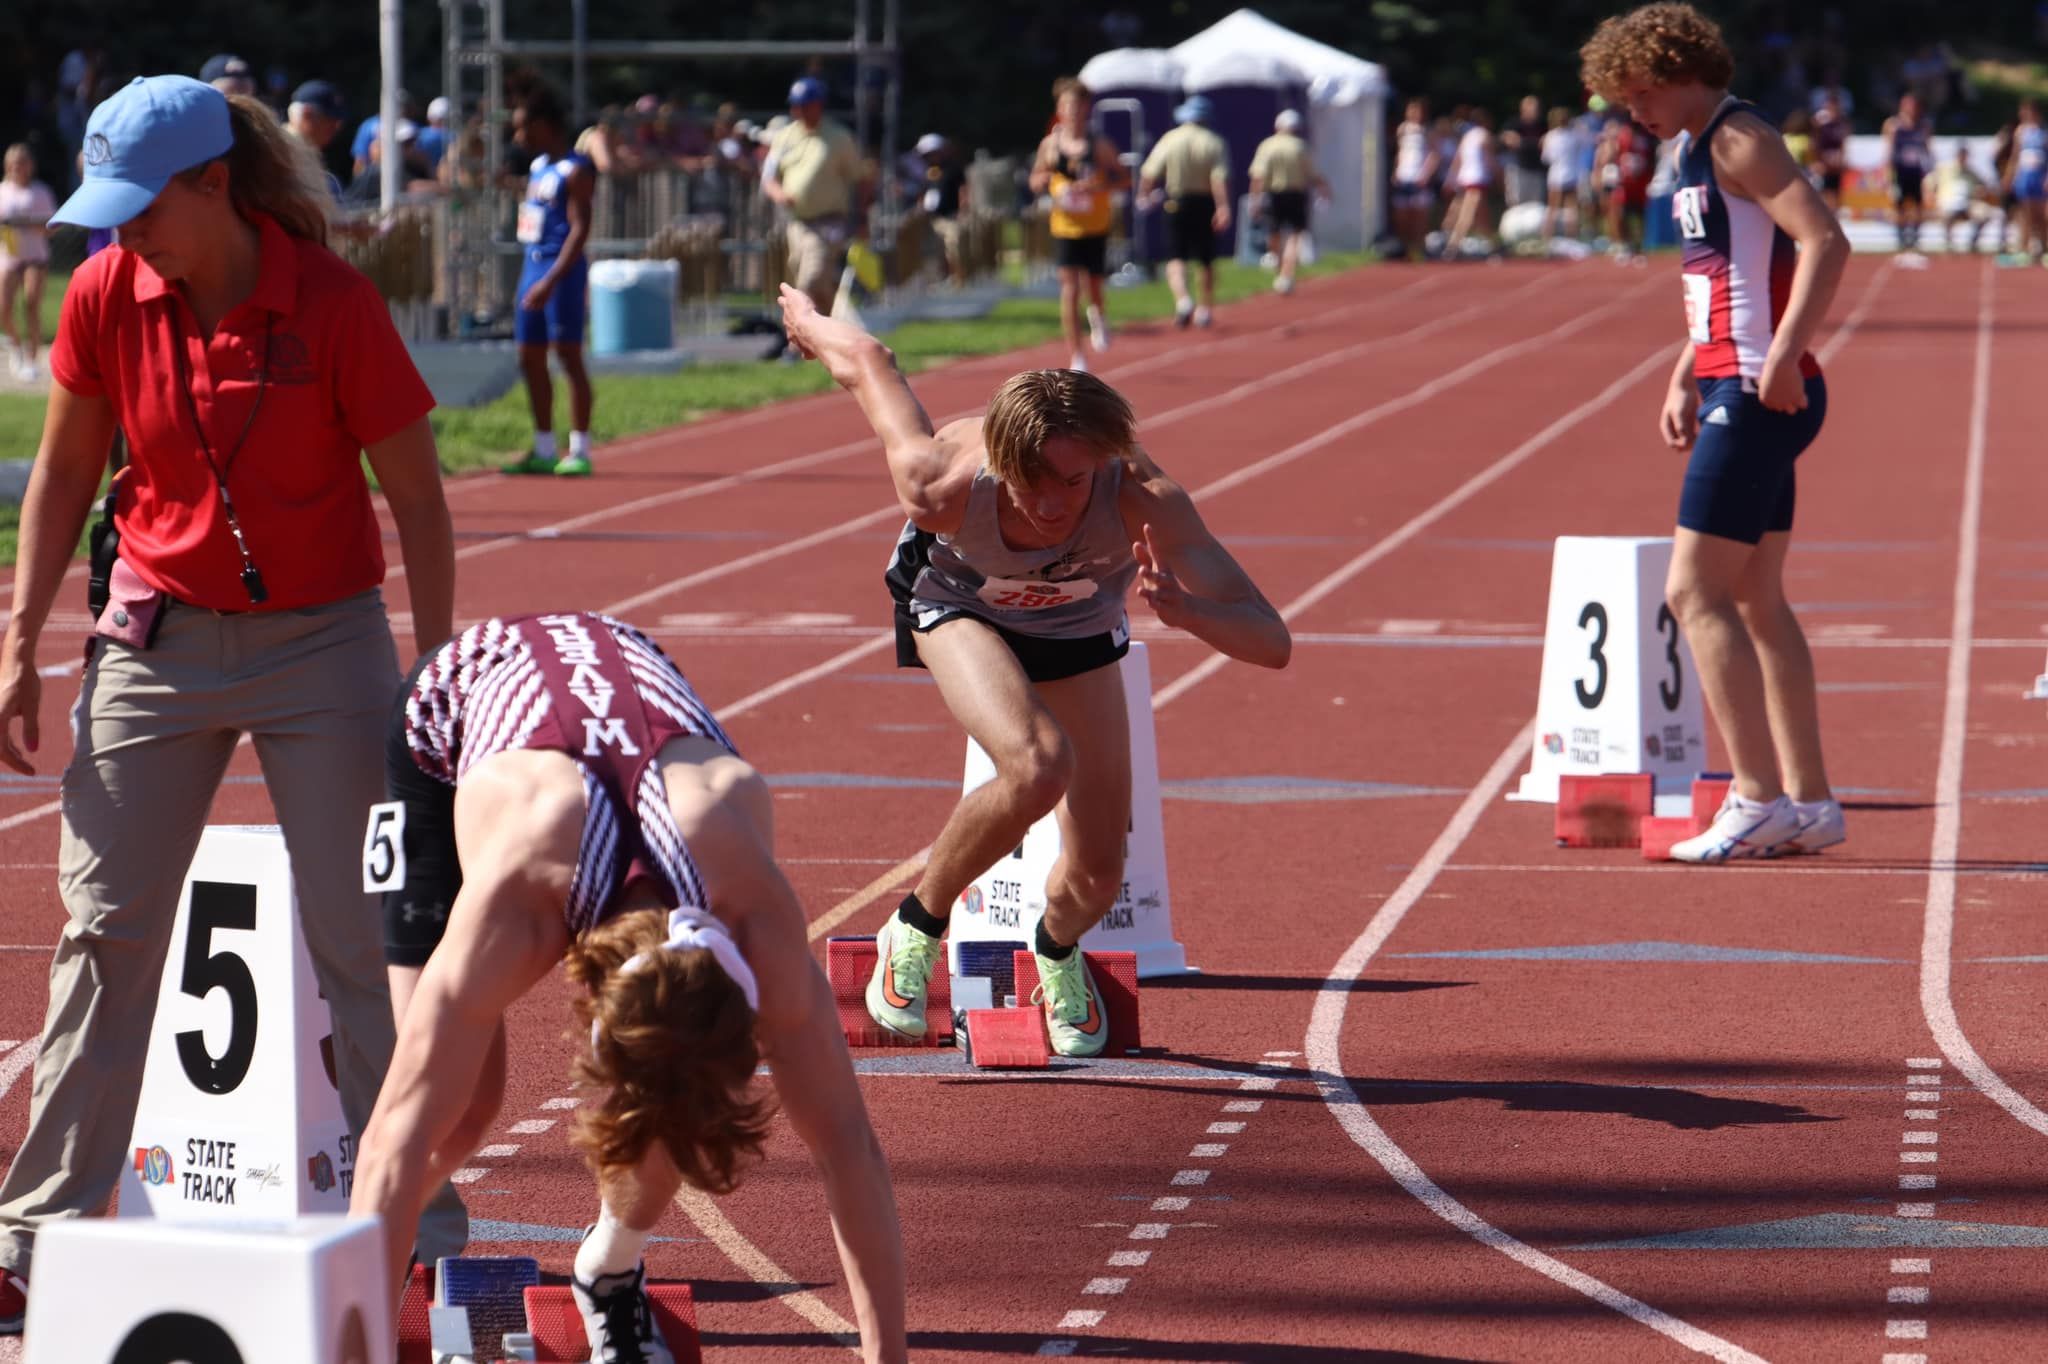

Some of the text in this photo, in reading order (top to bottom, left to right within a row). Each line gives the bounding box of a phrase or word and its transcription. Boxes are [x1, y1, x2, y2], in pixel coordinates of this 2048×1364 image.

[538, 615, 640, 756] WAVERL
[1575, 602, 1608, 709] 3
[1657, 602, 1682, 711] 3
[368, 812, 395, 883] 5
[989, 905, 1021, 928] TRACK
[992, 880, 1021, 902] STATE
[175, 880, 258, 1095] 5
[182, 1172, 237, 1205] TRACK
[186, 1137, 236, 1170] STATE
